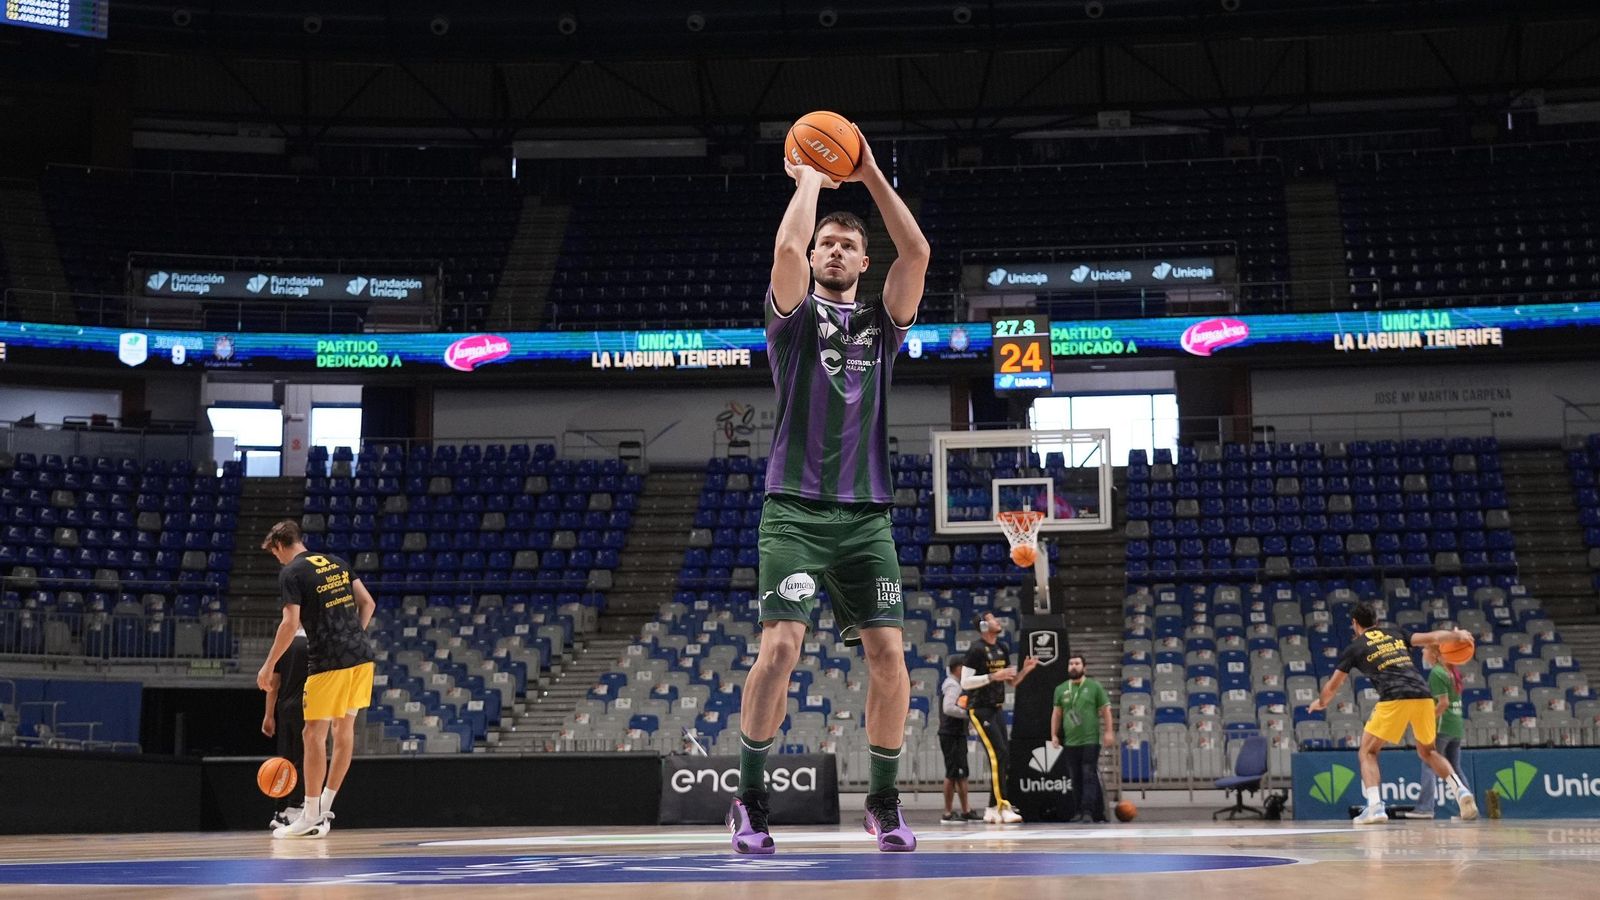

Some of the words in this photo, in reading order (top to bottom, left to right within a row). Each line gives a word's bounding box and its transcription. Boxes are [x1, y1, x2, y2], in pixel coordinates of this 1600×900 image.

[18, 13, 58, 26] JUGADOR
[810, 140, 838, 163] EVO
[171, 273, 224, 284] Fundación
[1008, 271, 1048, 286] Unicaja
[1091, 268, 1132, 284] Unicaja
[1172, 266, 1214, 280] Unicaja
[171, 282, 210, 295] Unicaja
[270, 275, 323, 287] Fundación
[370, 278, 422, 289] Fundación
[270, 285, 309, 297] Unicaja
[370, 287, 408, 300] Unicaja
[996, 320, 1036, 336] 27.3
[1382, 313, 1450, 330] UNICAJA
[1051, 326, 1112, 340] PARTIDO
[1334, 333, 1354, 350] LA
[1358, 331, 1422, 350] LAGUNA
[1424, 328, 1502, 348] TENERIFE
[317, 341, 377, 353] PARTIDO
[638, 334, 704, 350] UNICAJA
[908, 338, 922, 358] 9
[1051, 341, 1124, 356] DEDICADO
[1126, 340, 1138, 354] A
[172, 345, 186, 364] 9
[316, 354, 385, 368] DEDICADO
[386, 355, 402, 368] A
[592, 351, 610, 368] LA
[614, 350, 674, 368] LAGUNA
[679, 349, 750, 366] TENERIFE
[1000, 342, 1042, 373] 24
[1014, 376, 1047, 388] Unicaja
[1462, 388, 1512, 402] CARPENA
[881, 578, 900, 593] má
[877, 588, 901, 605] laga
[671, 767, 816, 794] endsa
[1361, 777, 1456, 806] nicja
